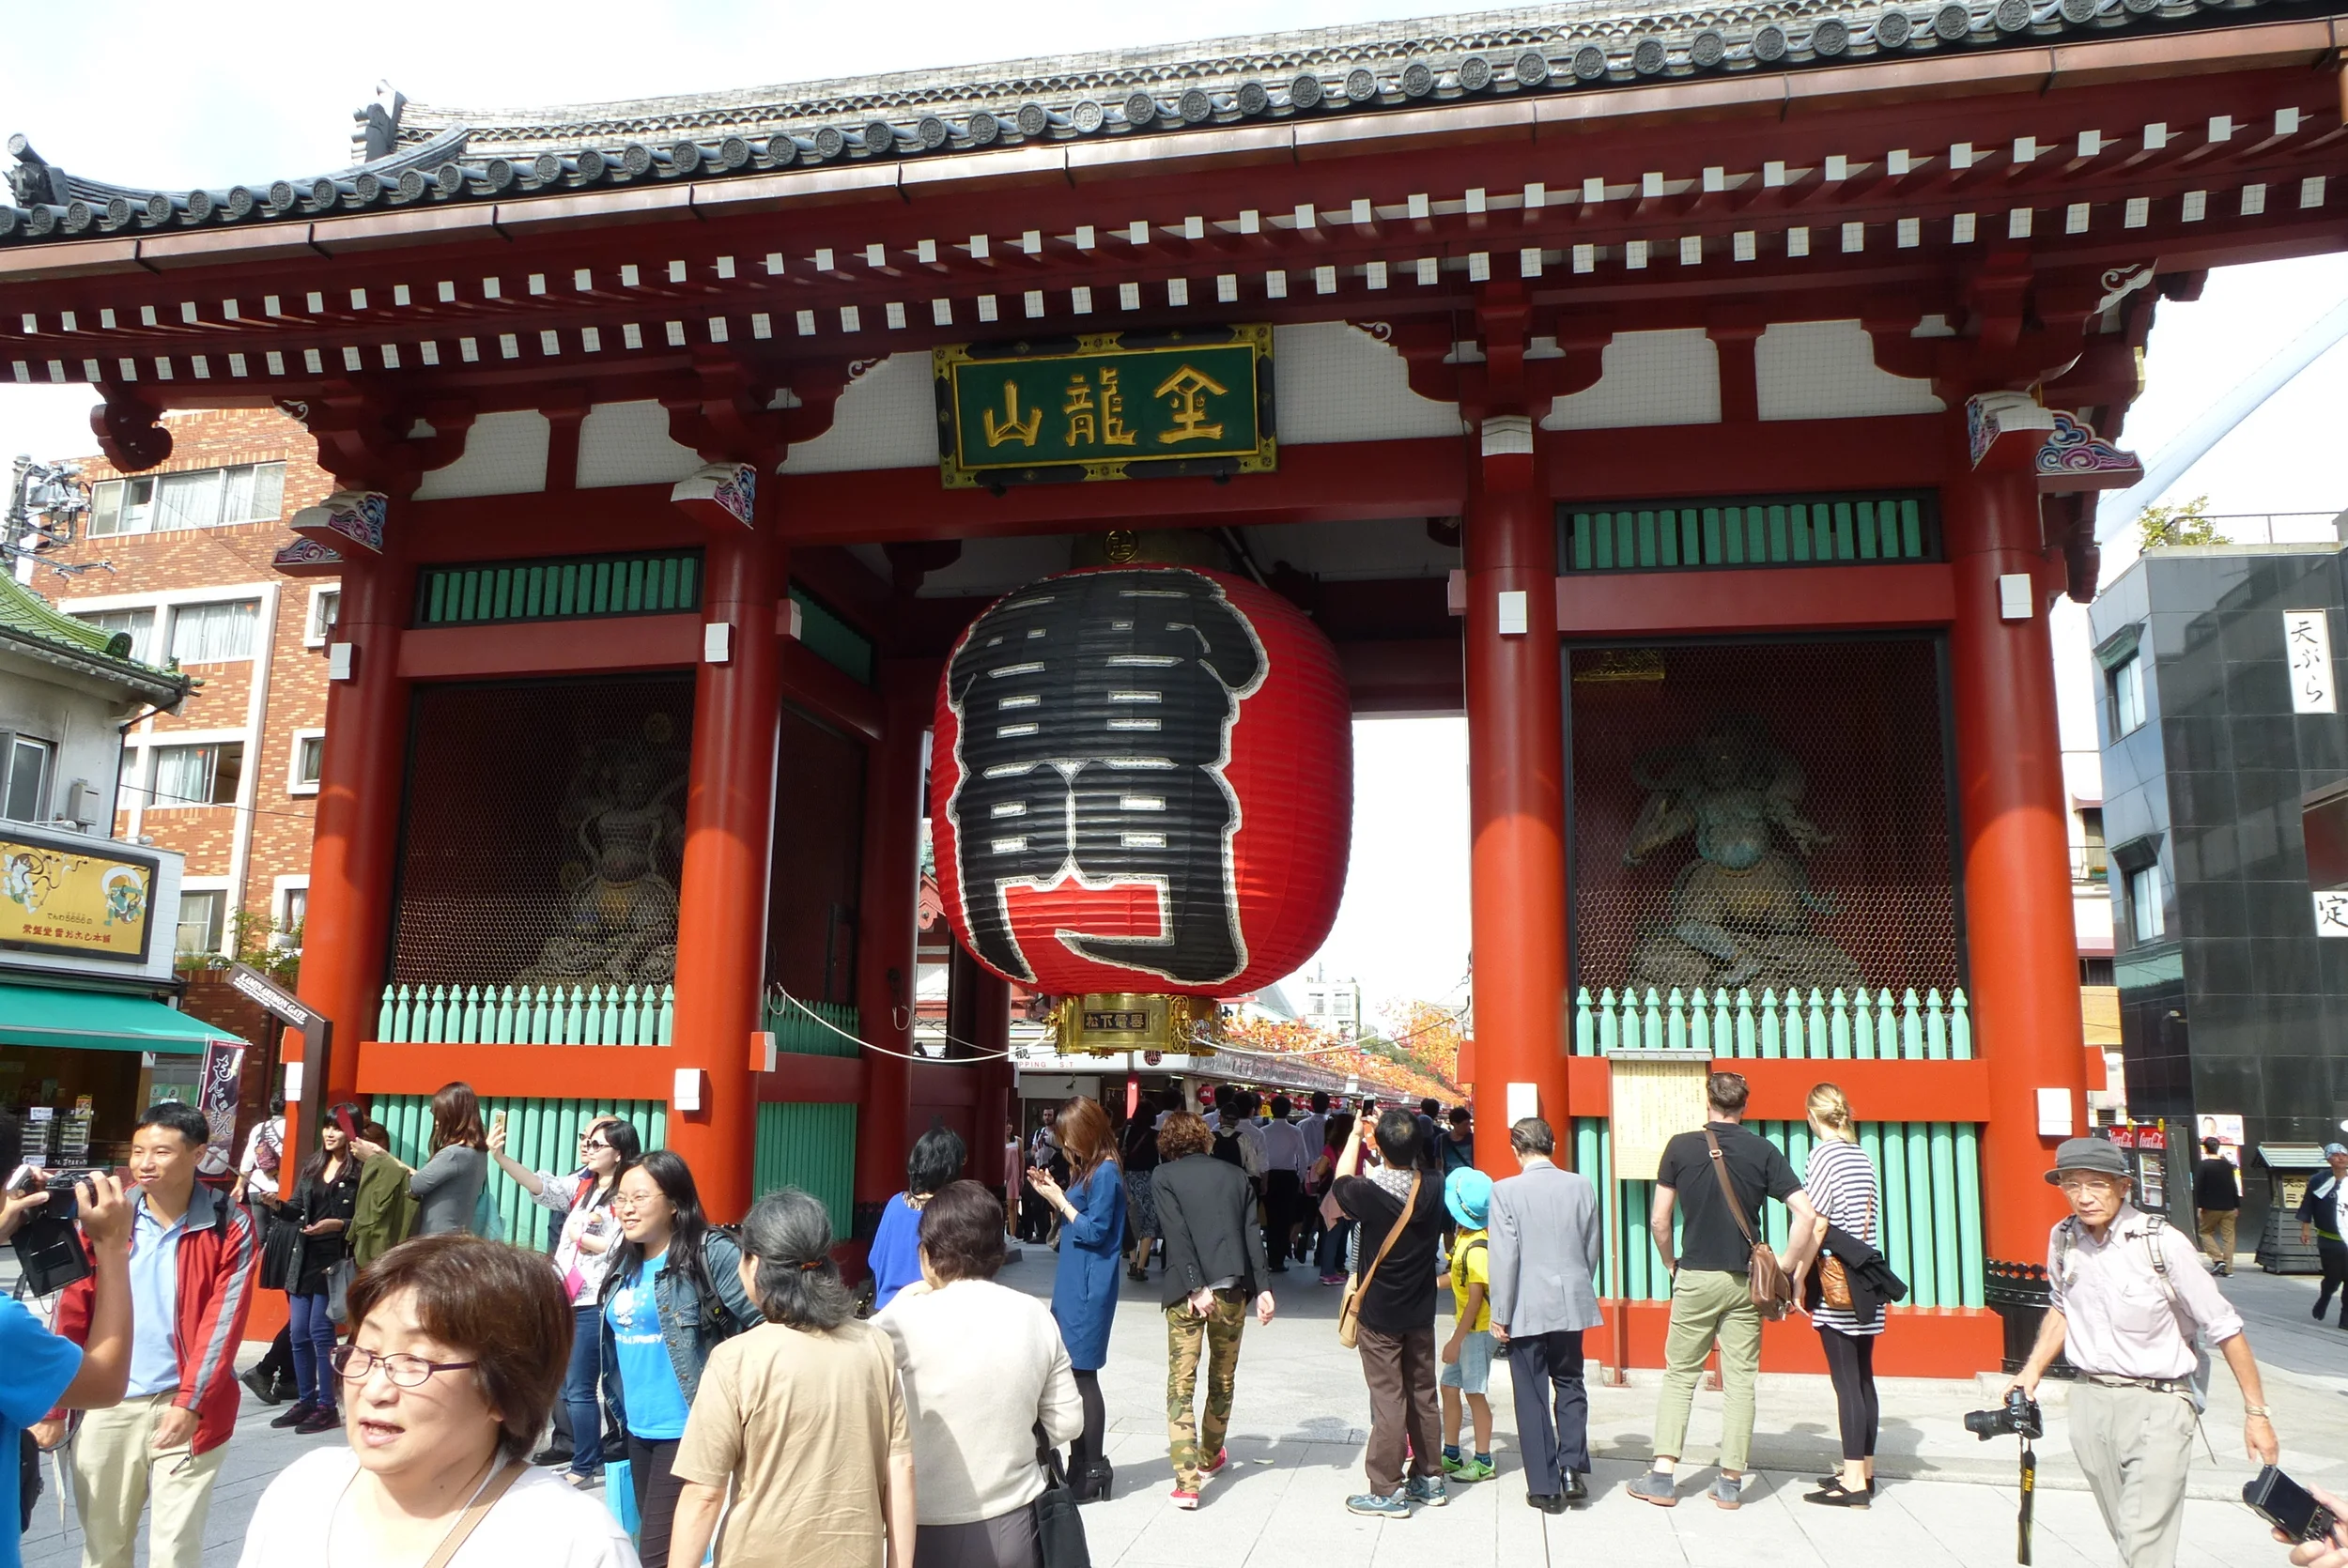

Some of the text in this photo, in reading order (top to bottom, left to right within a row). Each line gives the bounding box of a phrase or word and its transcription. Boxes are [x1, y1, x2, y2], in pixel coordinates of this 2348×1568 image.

[239, 973, 289, 1009] KAMINARIMON
[287, 1004, 308, 1021] GATE
[1086, 1014, 1144, 1028] 松下電器
[2024, 1468, 2033, 1492] Nikon
